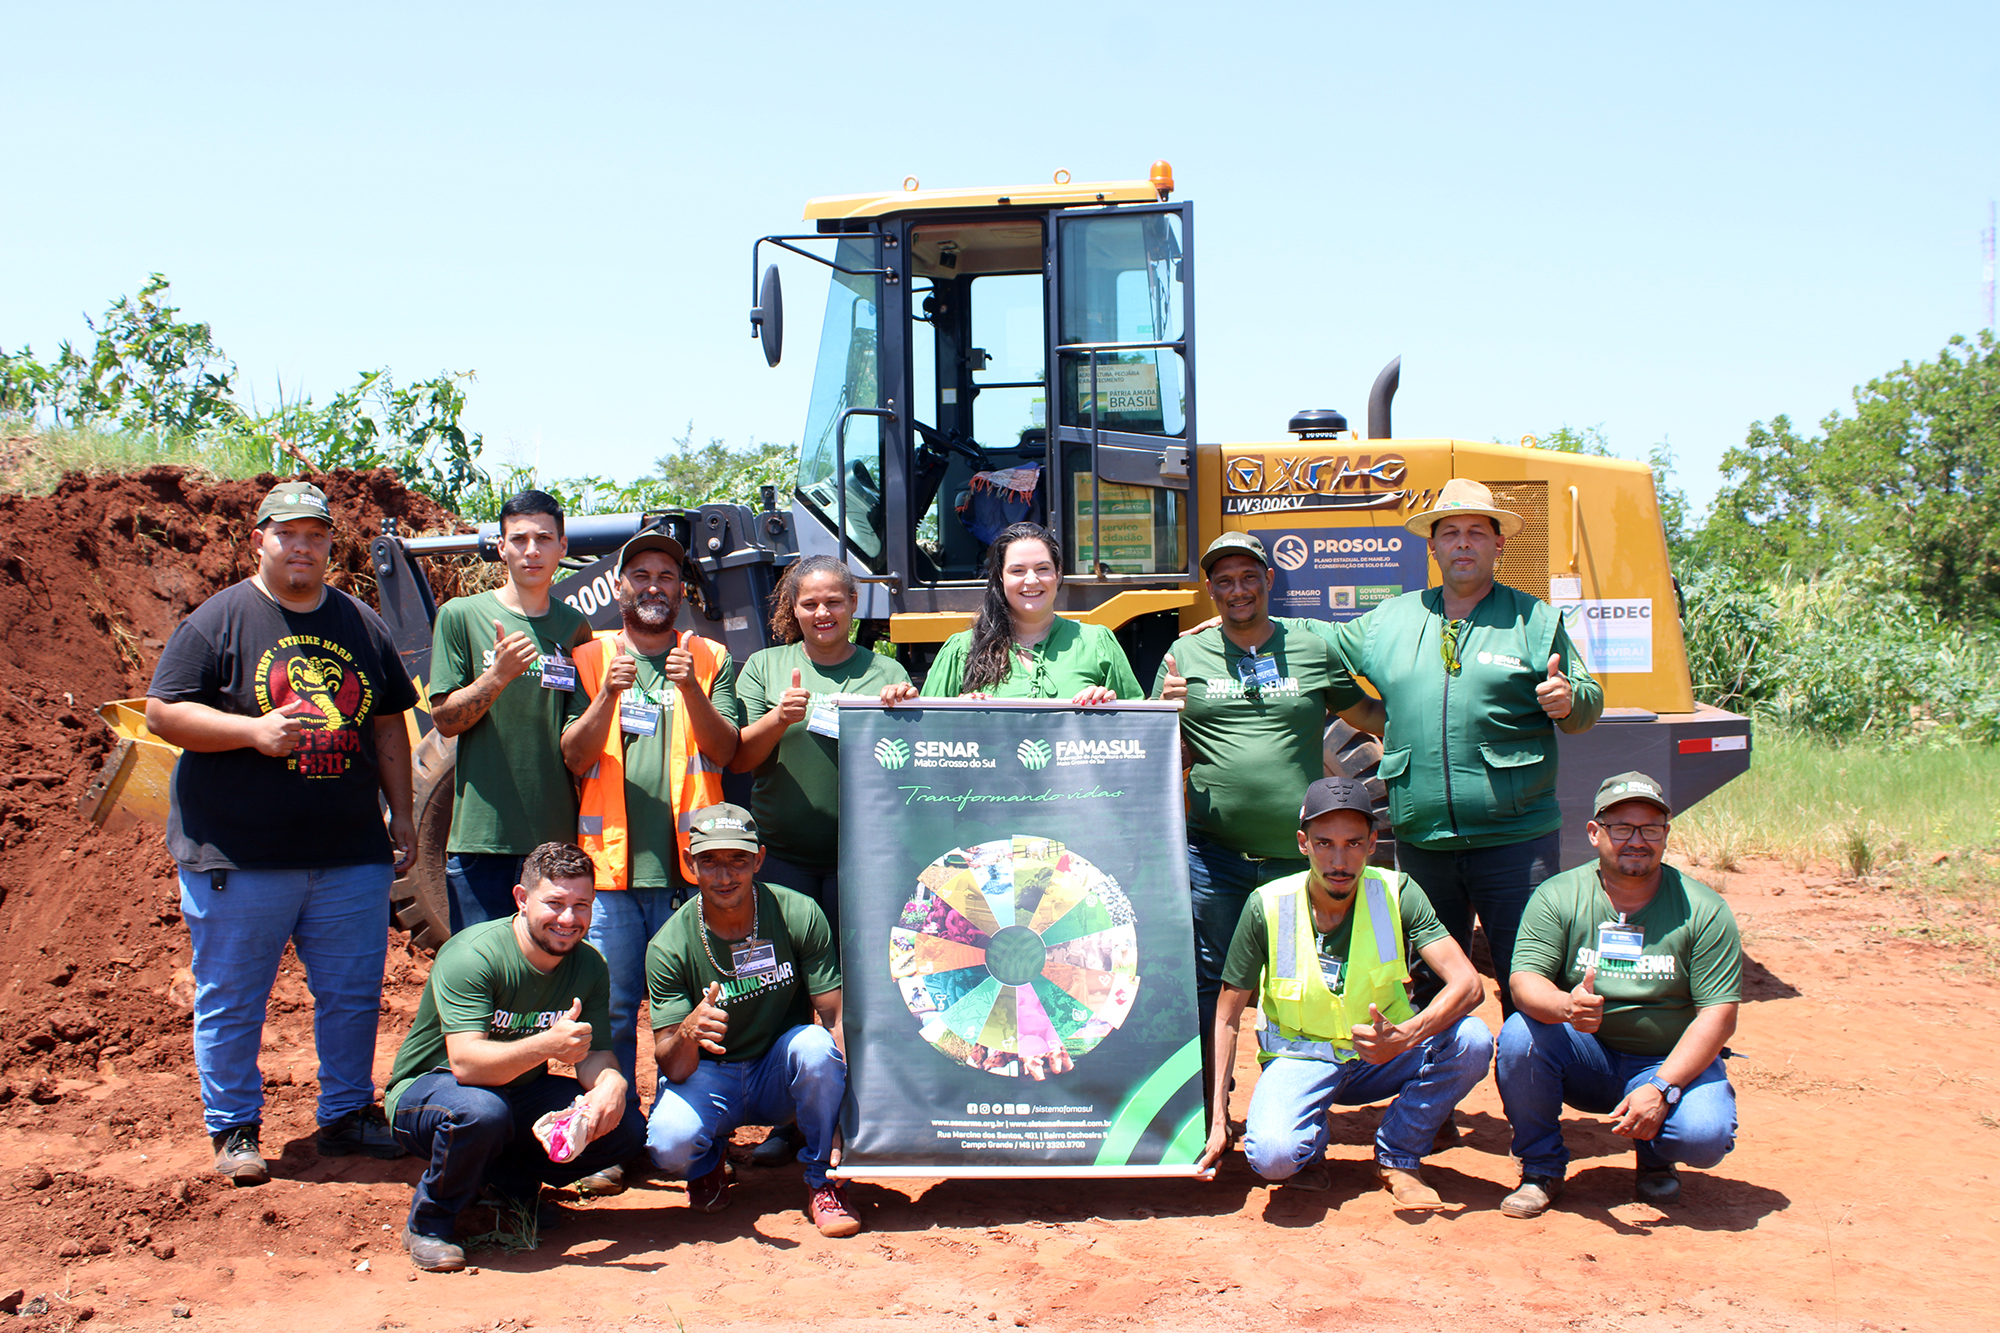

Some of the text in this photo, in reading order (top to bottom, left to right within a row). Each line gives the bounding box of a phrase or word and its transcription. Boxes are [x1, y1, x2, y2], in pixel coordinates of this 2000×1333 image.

[1110, 396, 1157, 408] BRASIL
[1266, 454, 1408, 492] XCMG
[1226, 496, 1305, 512] LW300KV
[1102, 533, 1143, 542] cidadão
[1314, 537, 1402, 553] PROSOLO
[1286, 589, 1321, 597] SEMAGRO
[1586, 606, 1651, 620] GEDEC
[278, 635, 321, 649] STRIKE
[322, 639, 352, 663] HARD
[1593, 645, 1645, 656] NAVIRAÍ
[255, 649, 275, 682] FIRST
[357, 671, 370, 686] NO
[354, 688, 373, 726] MERCY
[294, 728, 361, 752] OBRA
[914, 741, 980, 758] SENAR
[1055, 739, 1146, 756] FAMASUL
[914, 758, 996, 768] Mato Grosso do Sul
[898, 785, 1125, 812] Transformando vidas
[1601, 970, 1638, 980] GROSSO
[1031, 1104, 1094, 1114] /sistemafamasul
[1009, 1119, 1112, 1128] www.sistemafamasul.com.br
[937, 1130, 952, 1139] Rua
[952, 1130, 981, 1139] Marcino
[982, 1131, 996, 1139] dos
[996, 1131, 1024, 1140] Santos,
[1043, 1131, 1066, 1139] Bairro
[1066, 1131, 1102, 1139] Cachoeira
[961, 1140, 987, 1150] Campo
[987, 1140, 1014, 1149] Grande
[1019, 1141, 1031, 1149] MS
[1035, 1141, 1045, 1149] 67
